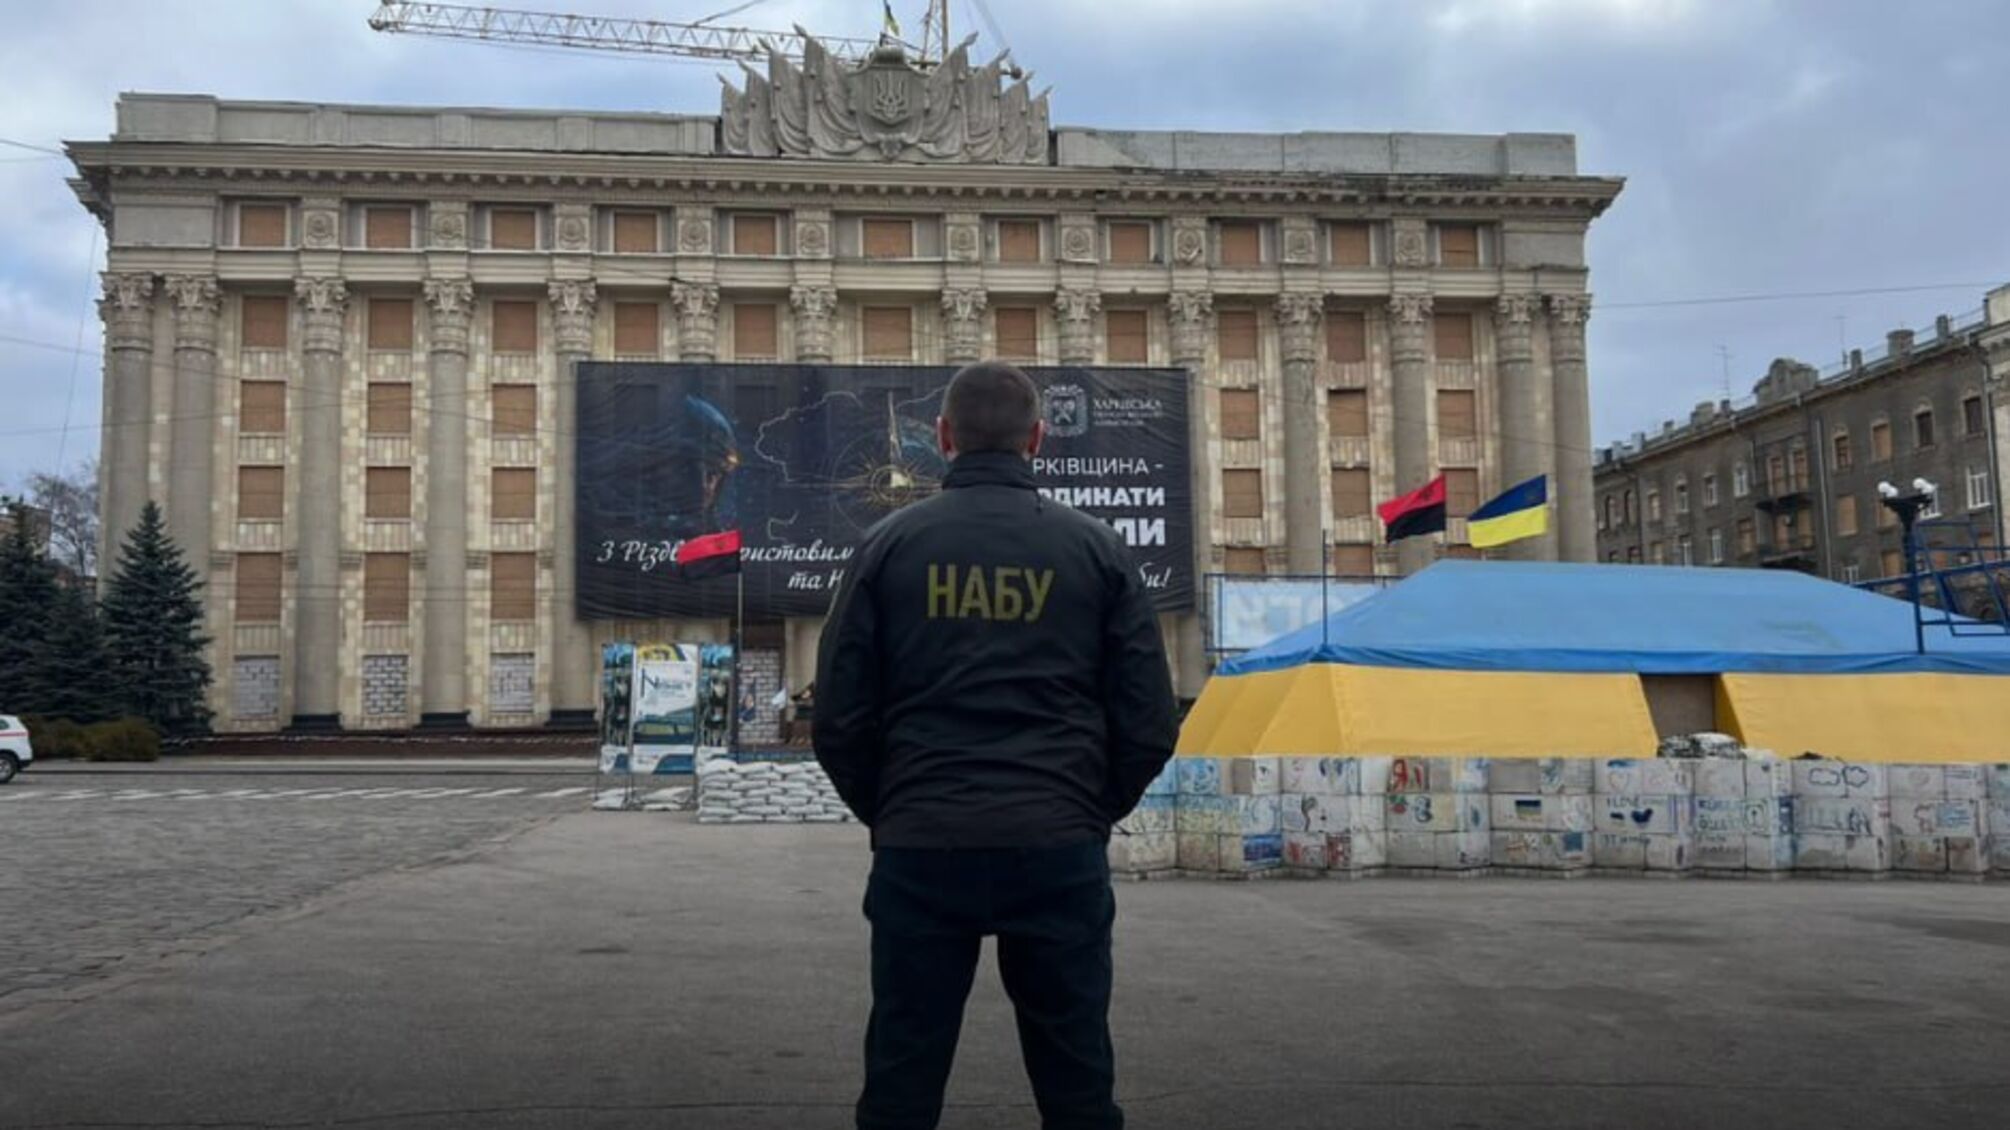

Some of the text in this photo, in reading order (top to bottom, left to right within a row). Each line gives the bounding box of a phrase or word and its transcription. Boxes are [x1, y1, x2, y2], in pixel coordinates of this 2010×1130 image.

[1032, 457, 1150, 477] РКІВЩИНА
[1112, 517, 1166, 547] ЛИ
[739, 538, 855, 562] ристовим
[787, 571, 823, 590] та
[927, 563, 1055, 622] НАБУ
